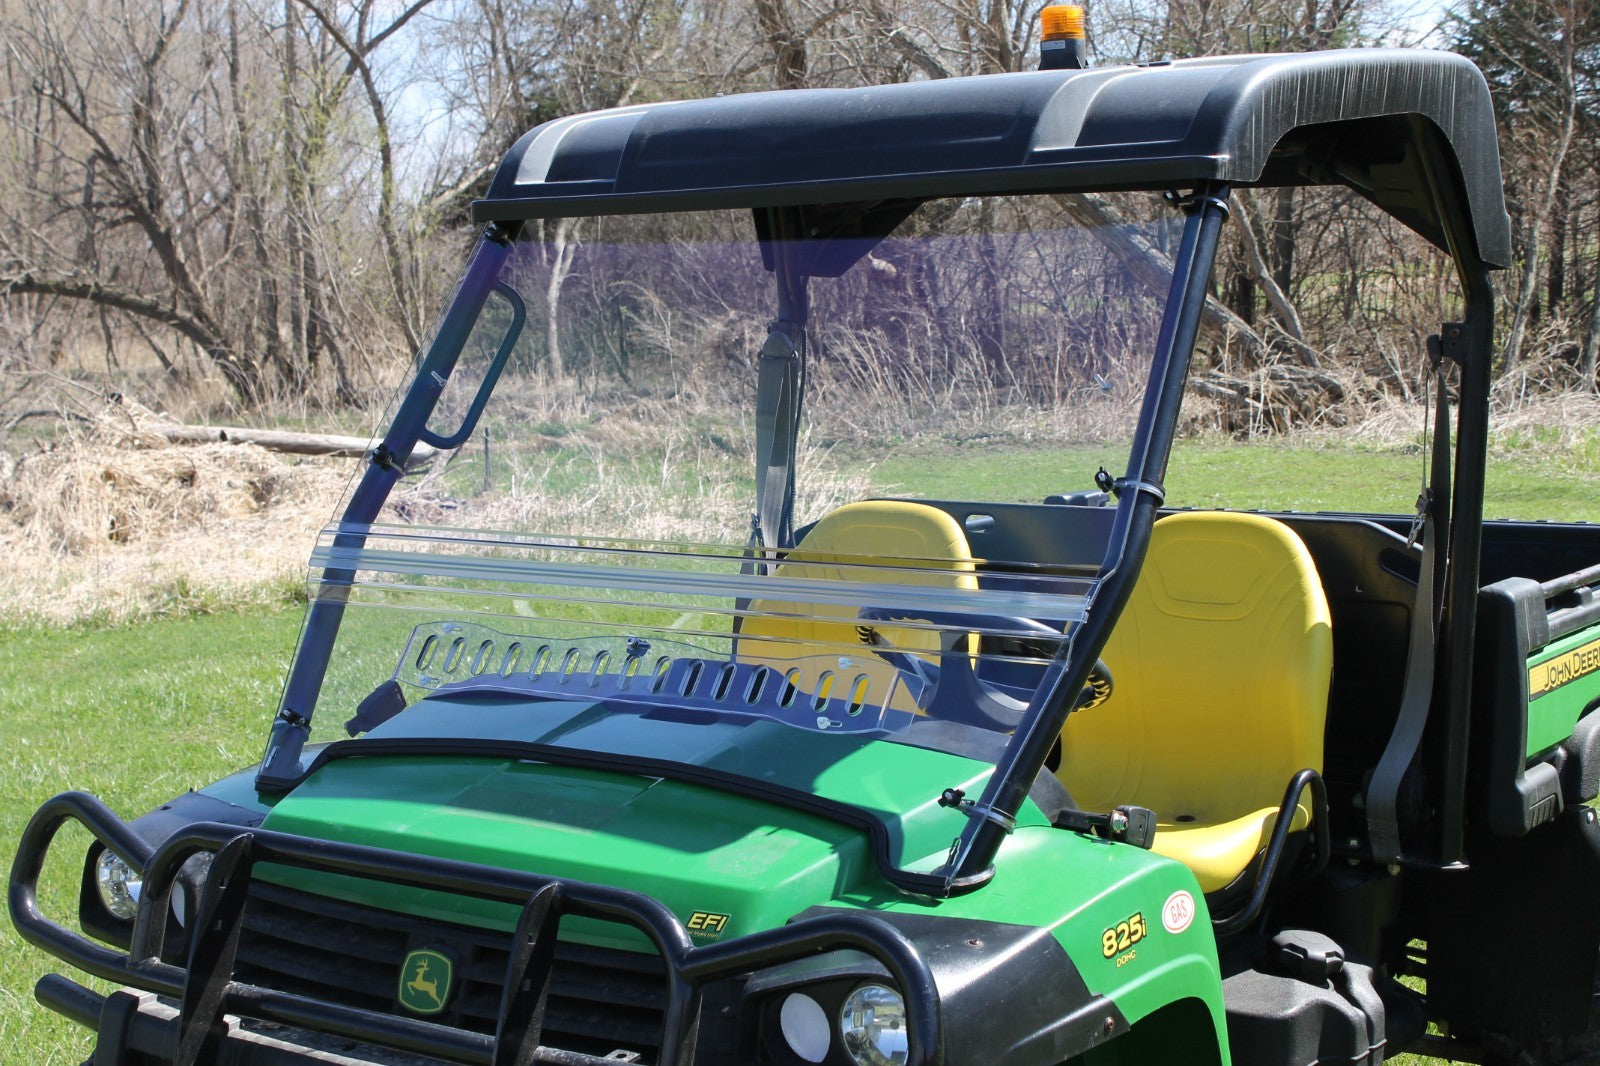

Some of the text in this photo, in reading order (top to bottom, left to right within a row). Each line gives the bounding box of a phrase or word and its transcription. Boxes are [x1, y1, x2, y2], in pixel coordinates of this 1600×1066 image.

[1544, 646, 1600, 688] JOHN DEER
[687, 912, 728, 931] EFI
[1170, 900, 1188, 923] GAS
[1102, 912, 1147, 958] 825i
